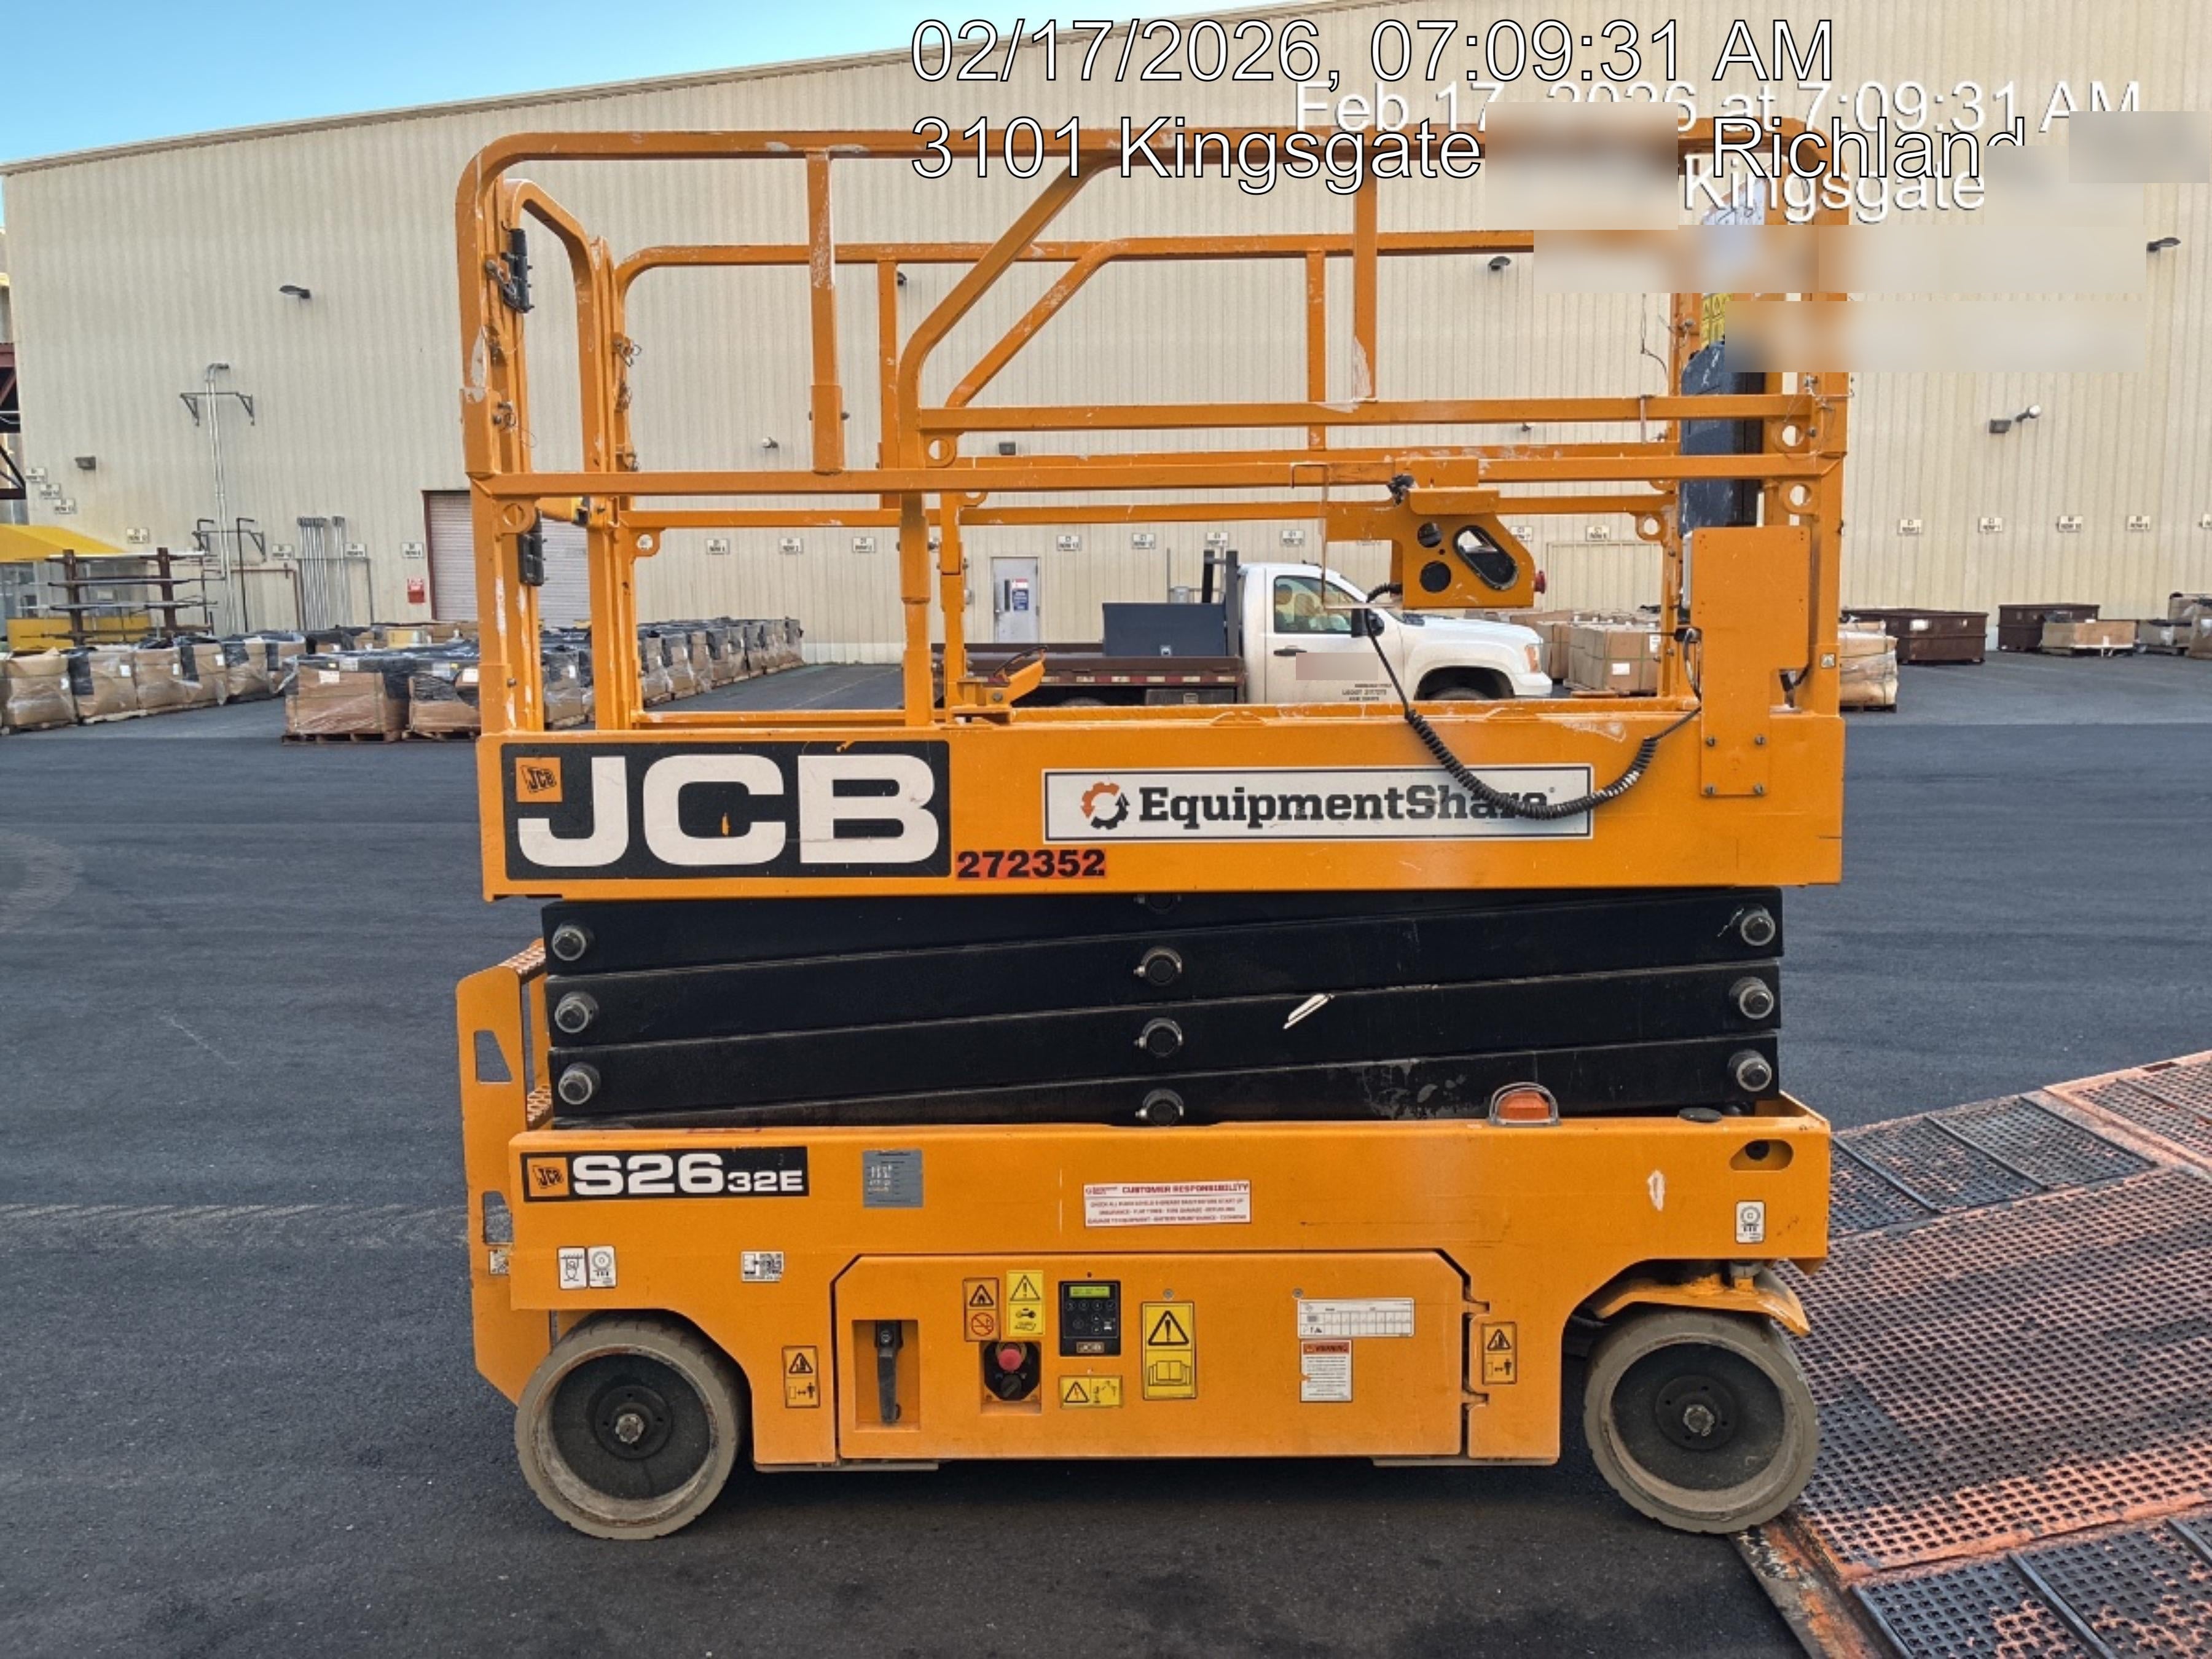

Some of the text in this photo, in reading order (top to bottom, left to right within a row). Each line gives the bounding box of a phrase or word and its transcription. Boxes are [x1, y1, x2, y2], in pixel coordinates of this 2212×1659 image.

[524, 767, 557, 791] JCB
[517, 753, 939, 867] JCB
[957, 849, 1105, 879] 272352
[1172, 1183, 1249, 1193] RESPONSIBILITY
